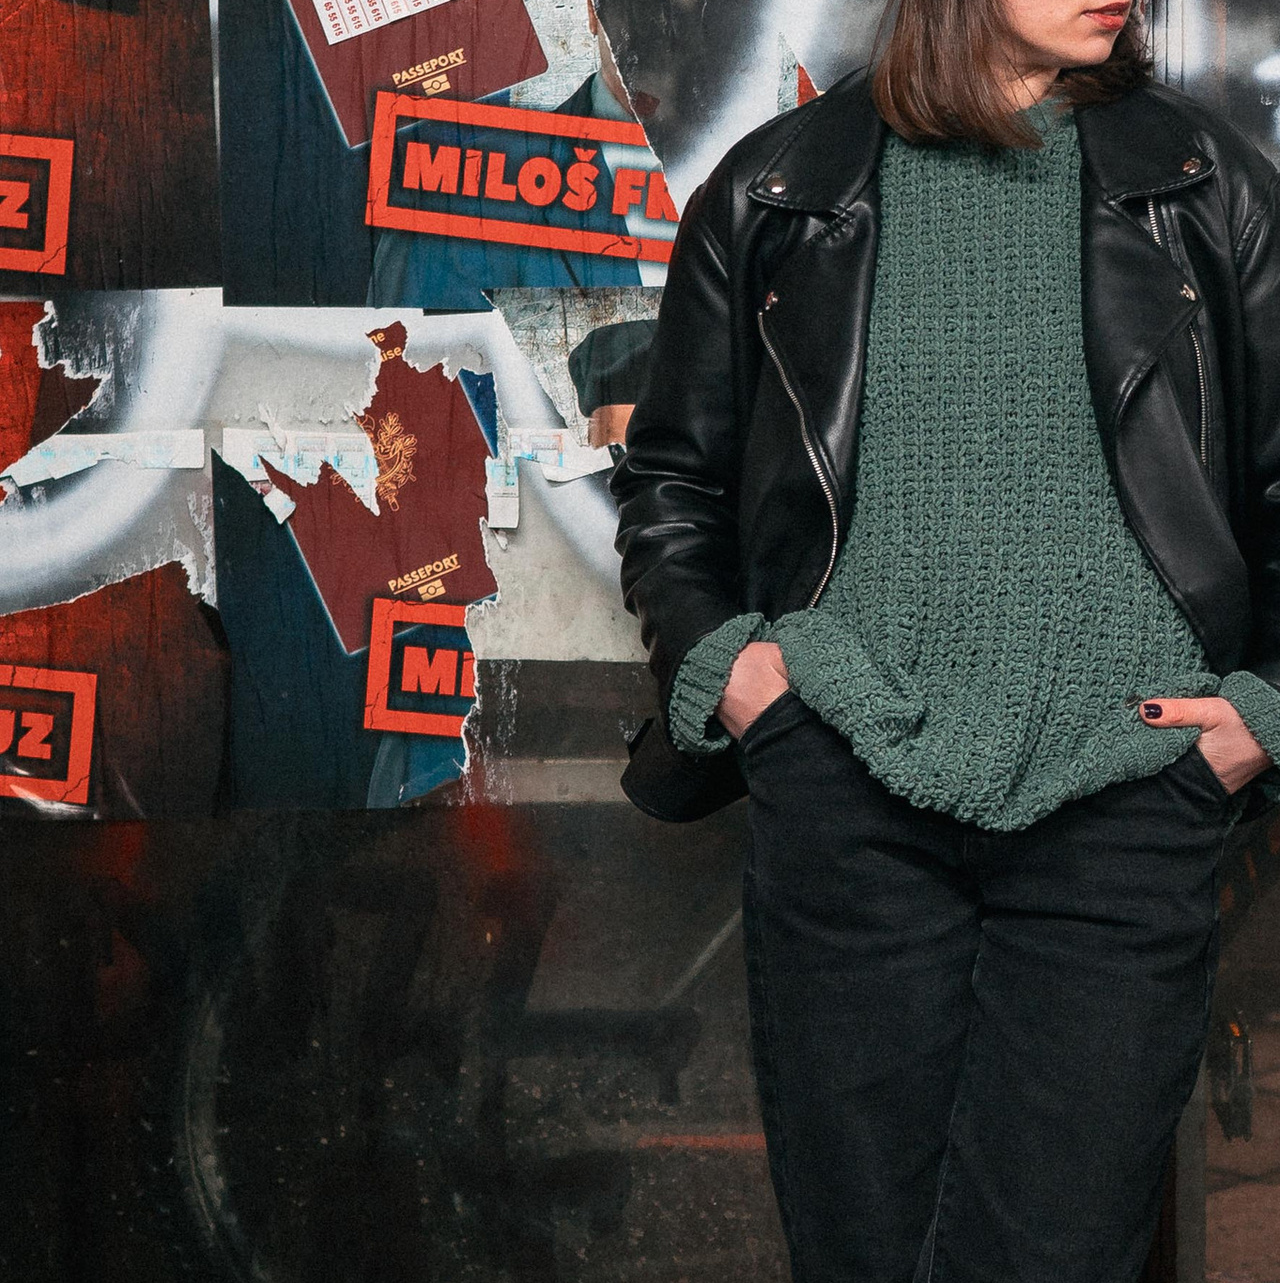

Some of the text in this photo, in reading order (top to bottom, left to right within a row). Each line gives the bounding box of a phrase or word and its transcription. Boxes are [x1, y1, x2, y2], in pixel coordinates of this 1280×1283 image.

[392, 48, 466, 86] PASSEPORT
[402, 141, 599, 212] MILOŠ
[388, 554, 460, 594] PASSEPORT
